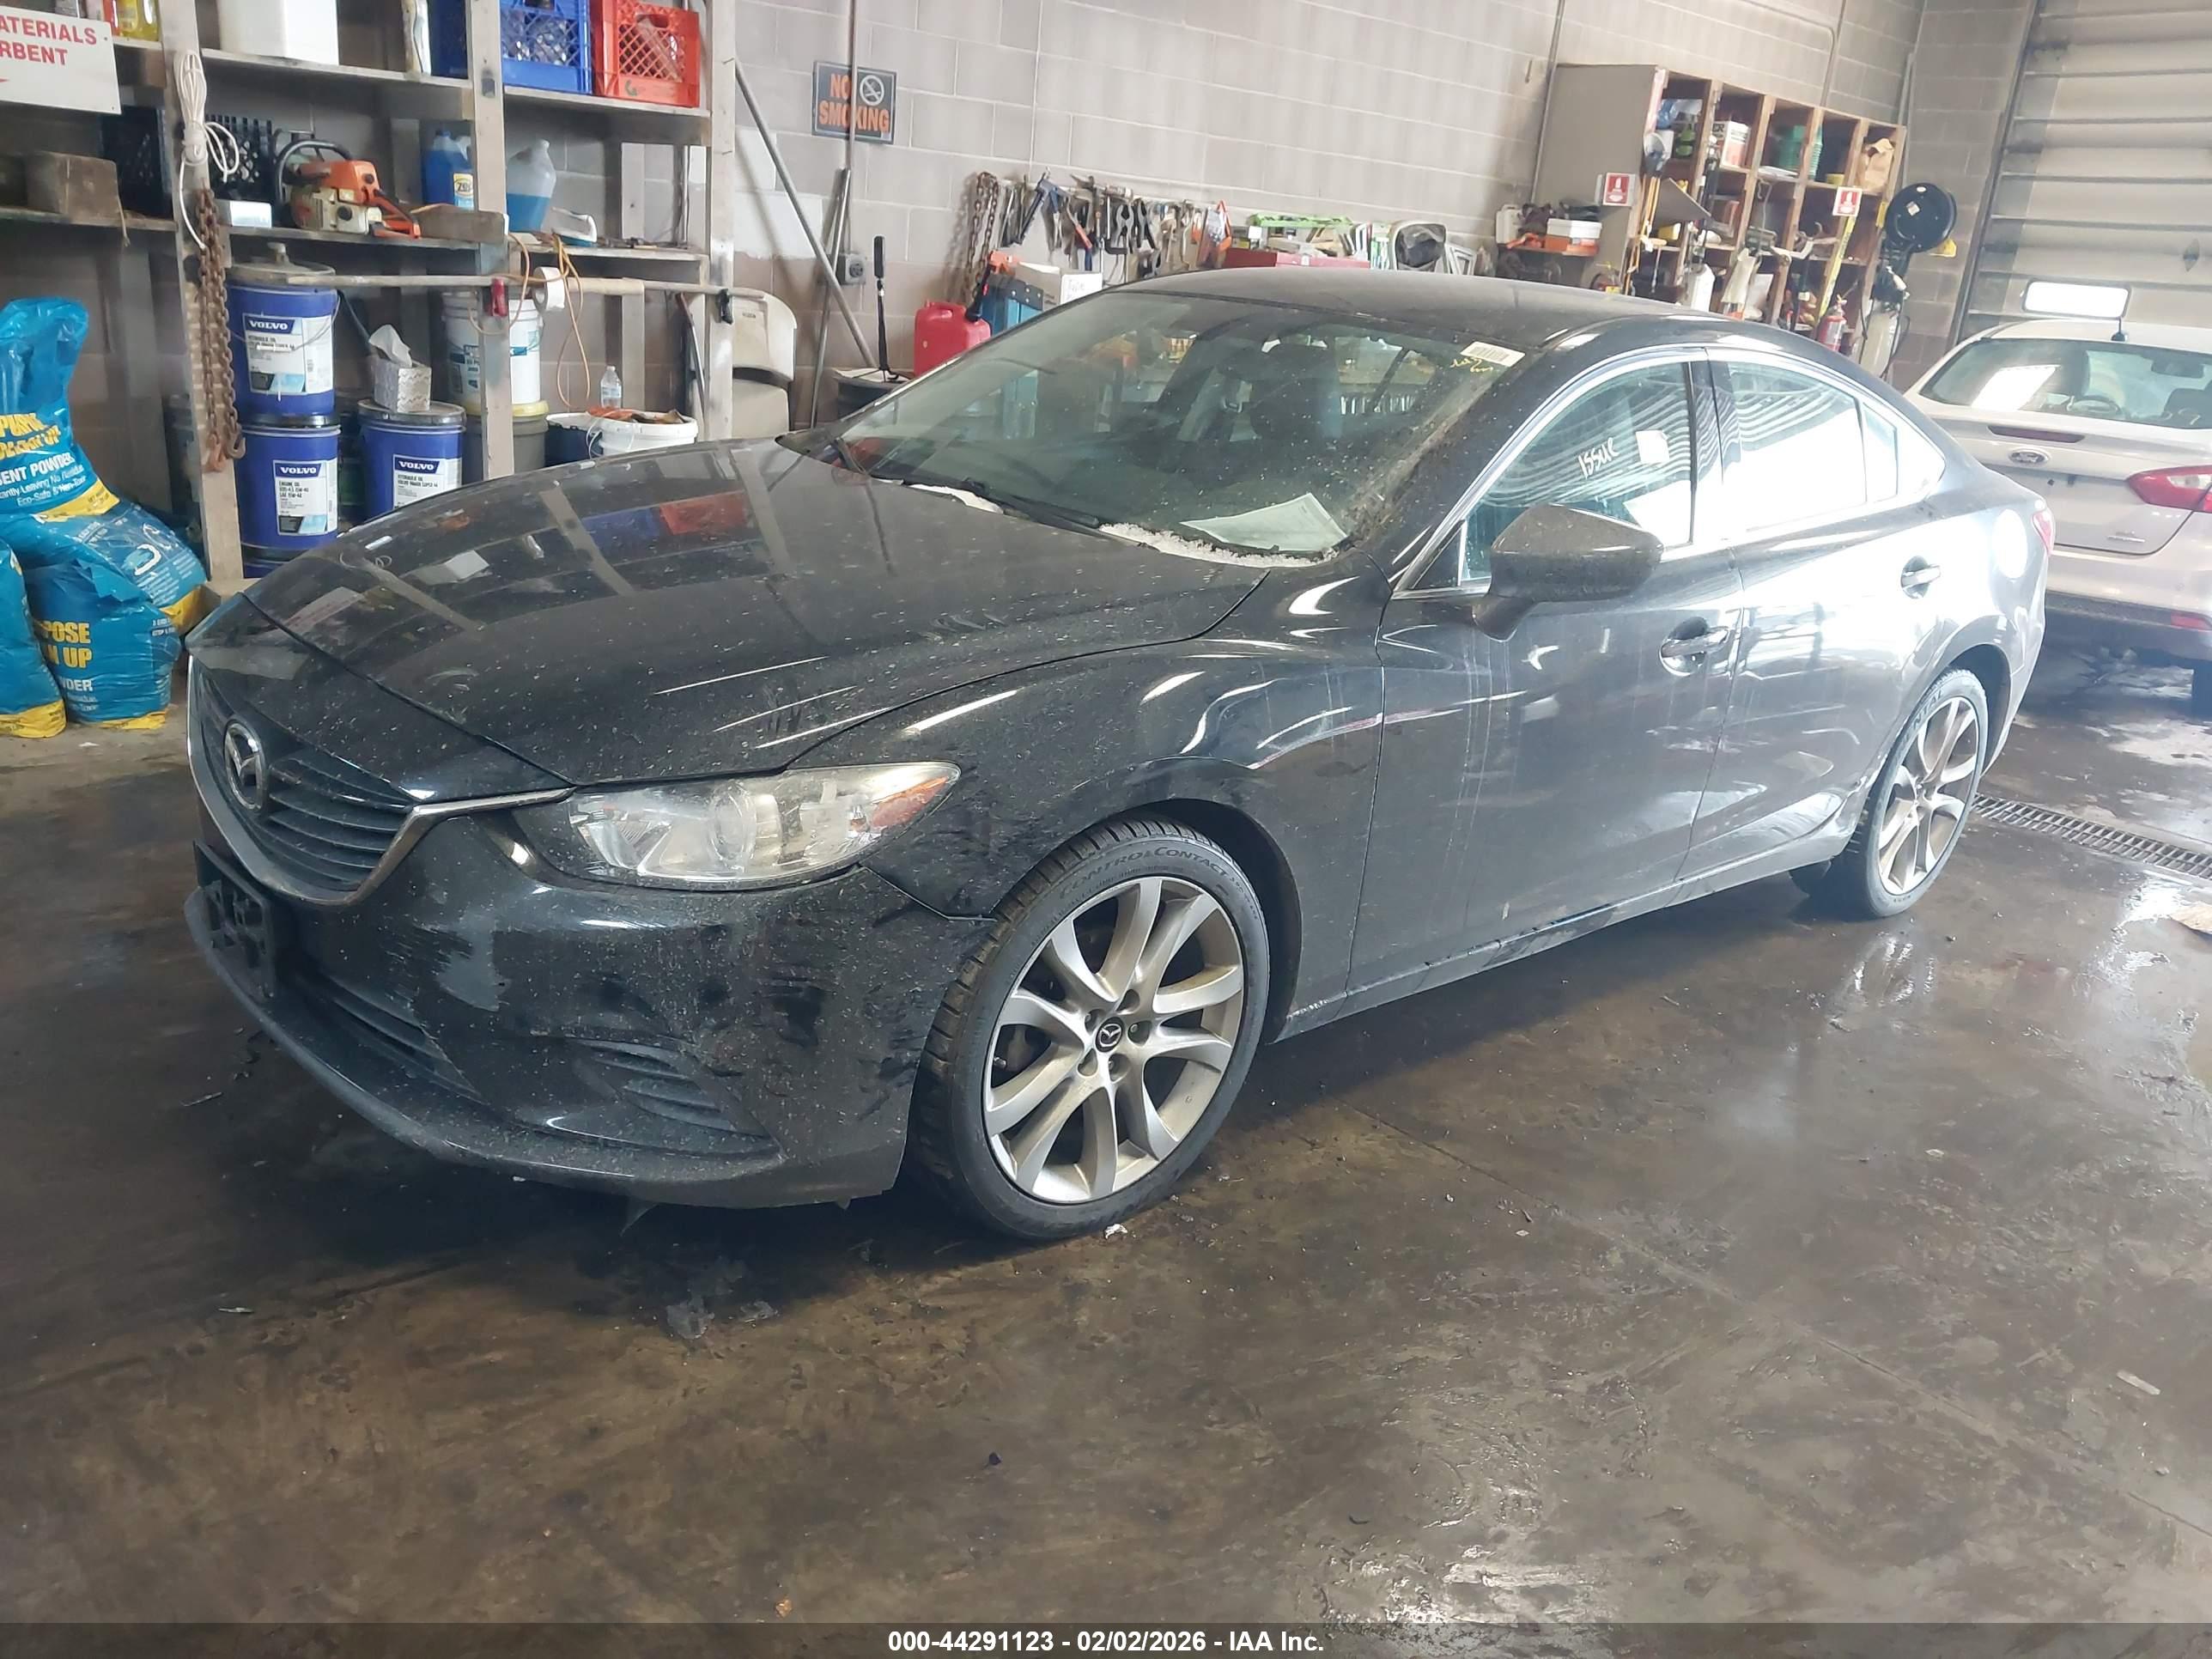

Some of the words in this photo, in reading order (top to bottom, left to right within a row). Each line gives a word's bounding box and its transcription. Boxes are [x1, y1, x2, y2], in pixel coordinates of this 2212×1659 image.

[830, 73, 852, 99] NO
[248, 319, 289, 331] VOLVO
[398, 460, 434, 471] VOLVO
[0, 466, 27, 486] ENT
[63, 647, 93, 668] UP
